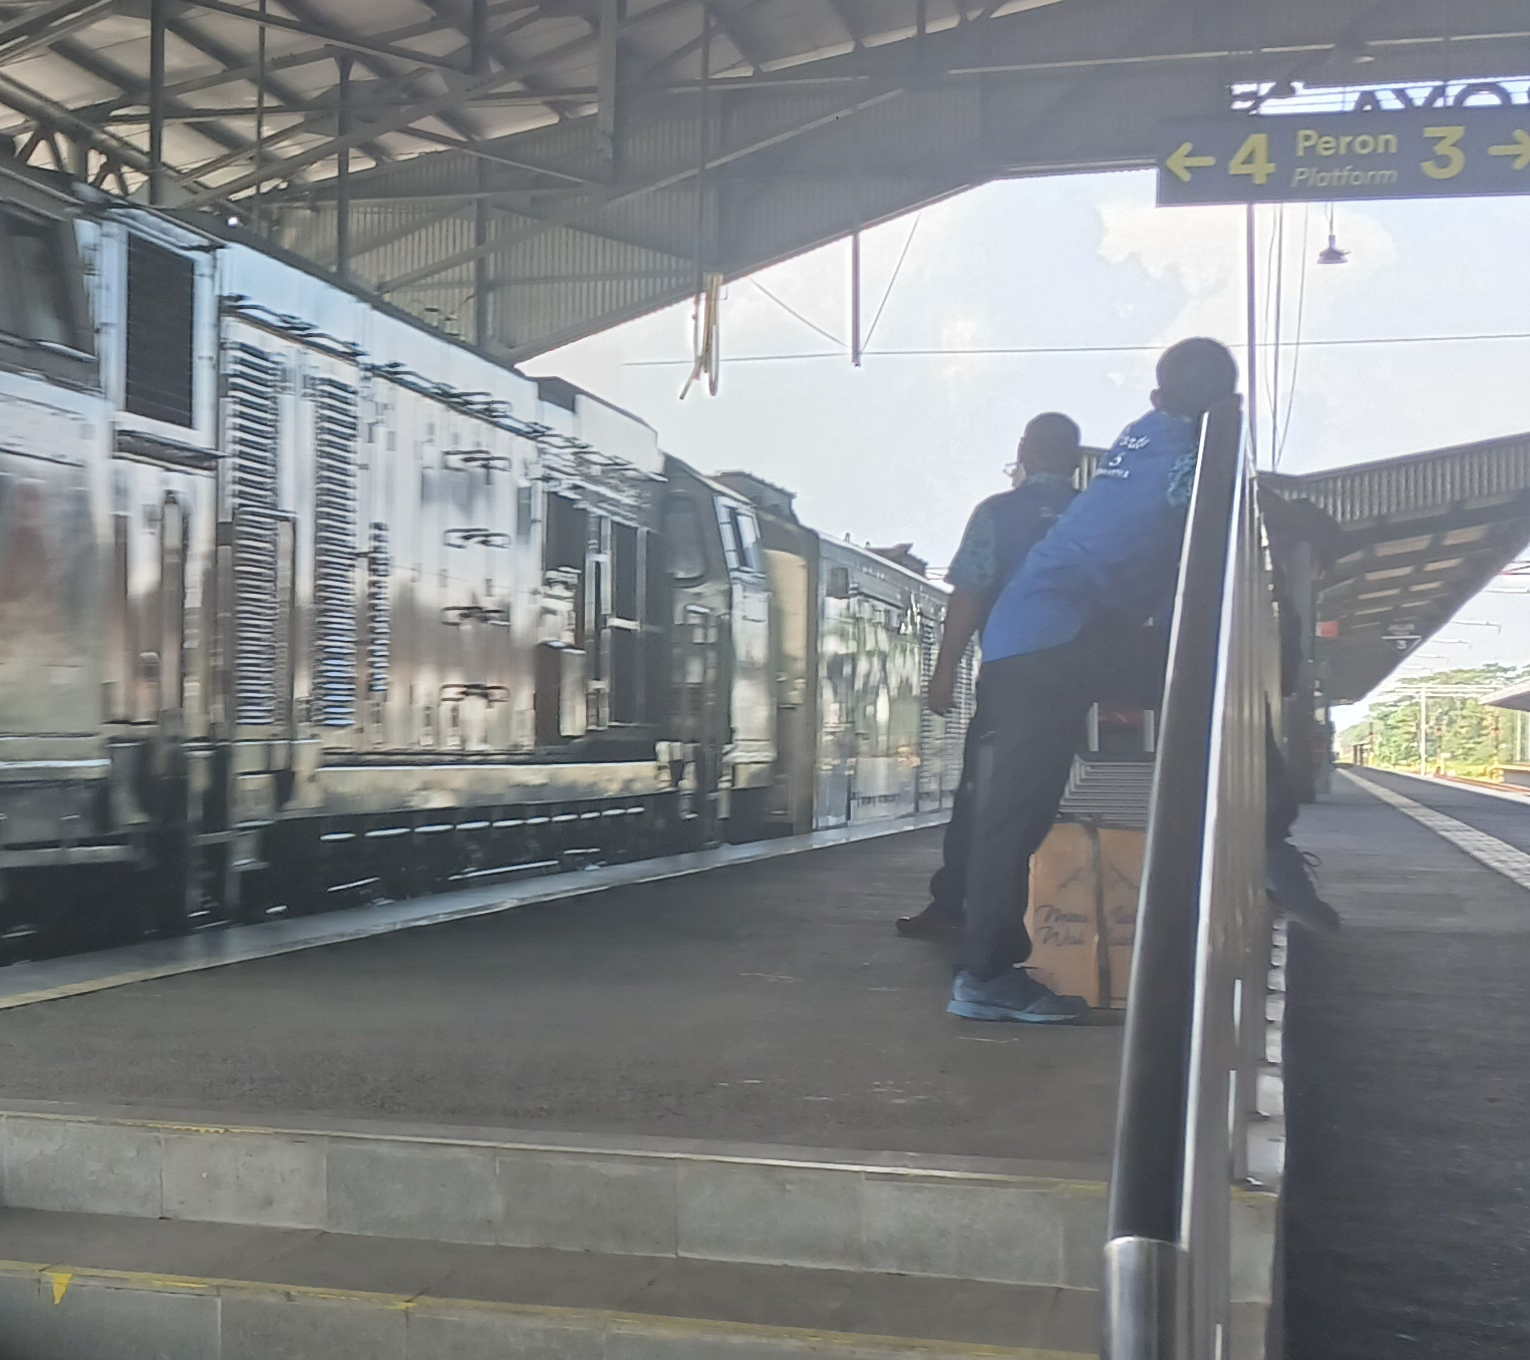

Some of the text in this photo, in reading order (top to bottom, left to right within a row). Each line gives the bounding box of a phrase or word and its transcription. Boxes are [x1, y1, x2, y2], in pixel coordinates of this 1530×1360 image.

[1228, 133, 1276, 185] 4
[1295, 129, 1398, 158] Peron
[1420, 125, 1466, 180] 3
[1290, 165, 1398, 188] Platform
